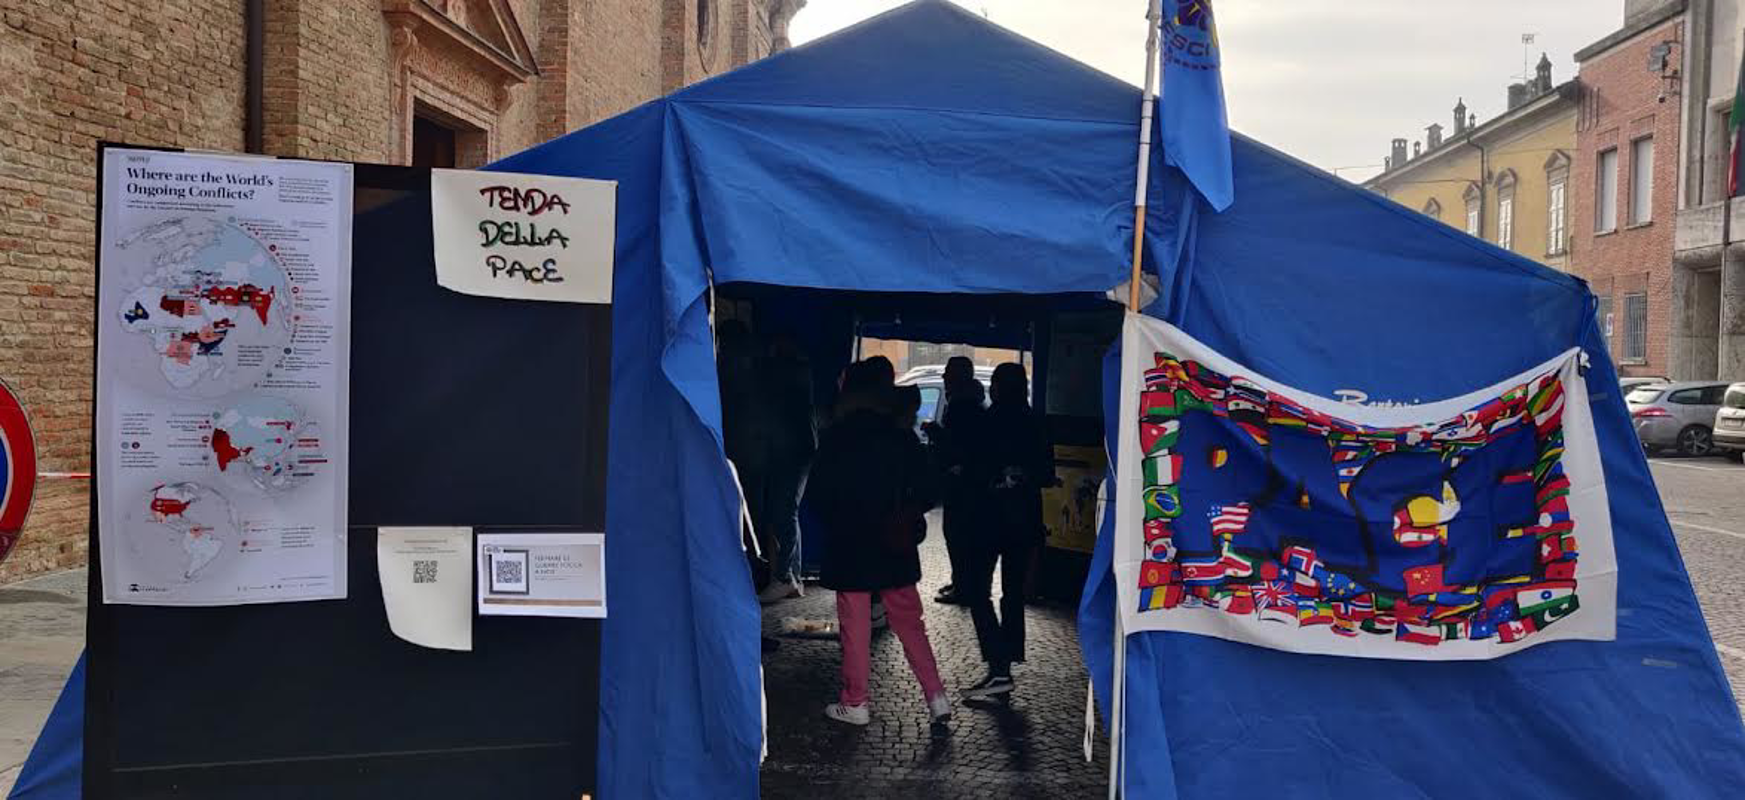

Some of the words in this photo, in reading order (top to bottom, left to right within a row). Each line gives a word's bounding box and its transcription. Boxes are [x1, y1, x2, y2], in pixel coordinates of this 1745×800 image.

[127, 167, 173, 181] Where
[175, 171, 198, 182] are
[201, 171, 223, 183] the
[226, 173, 273, 186] World's
[127, 182, 186, 199] Ongoing
[189, 186, 255, 200] Conflicts?
[479, 186, 571, 216] TENDA
[478, 219, 570, 250] DELLA
